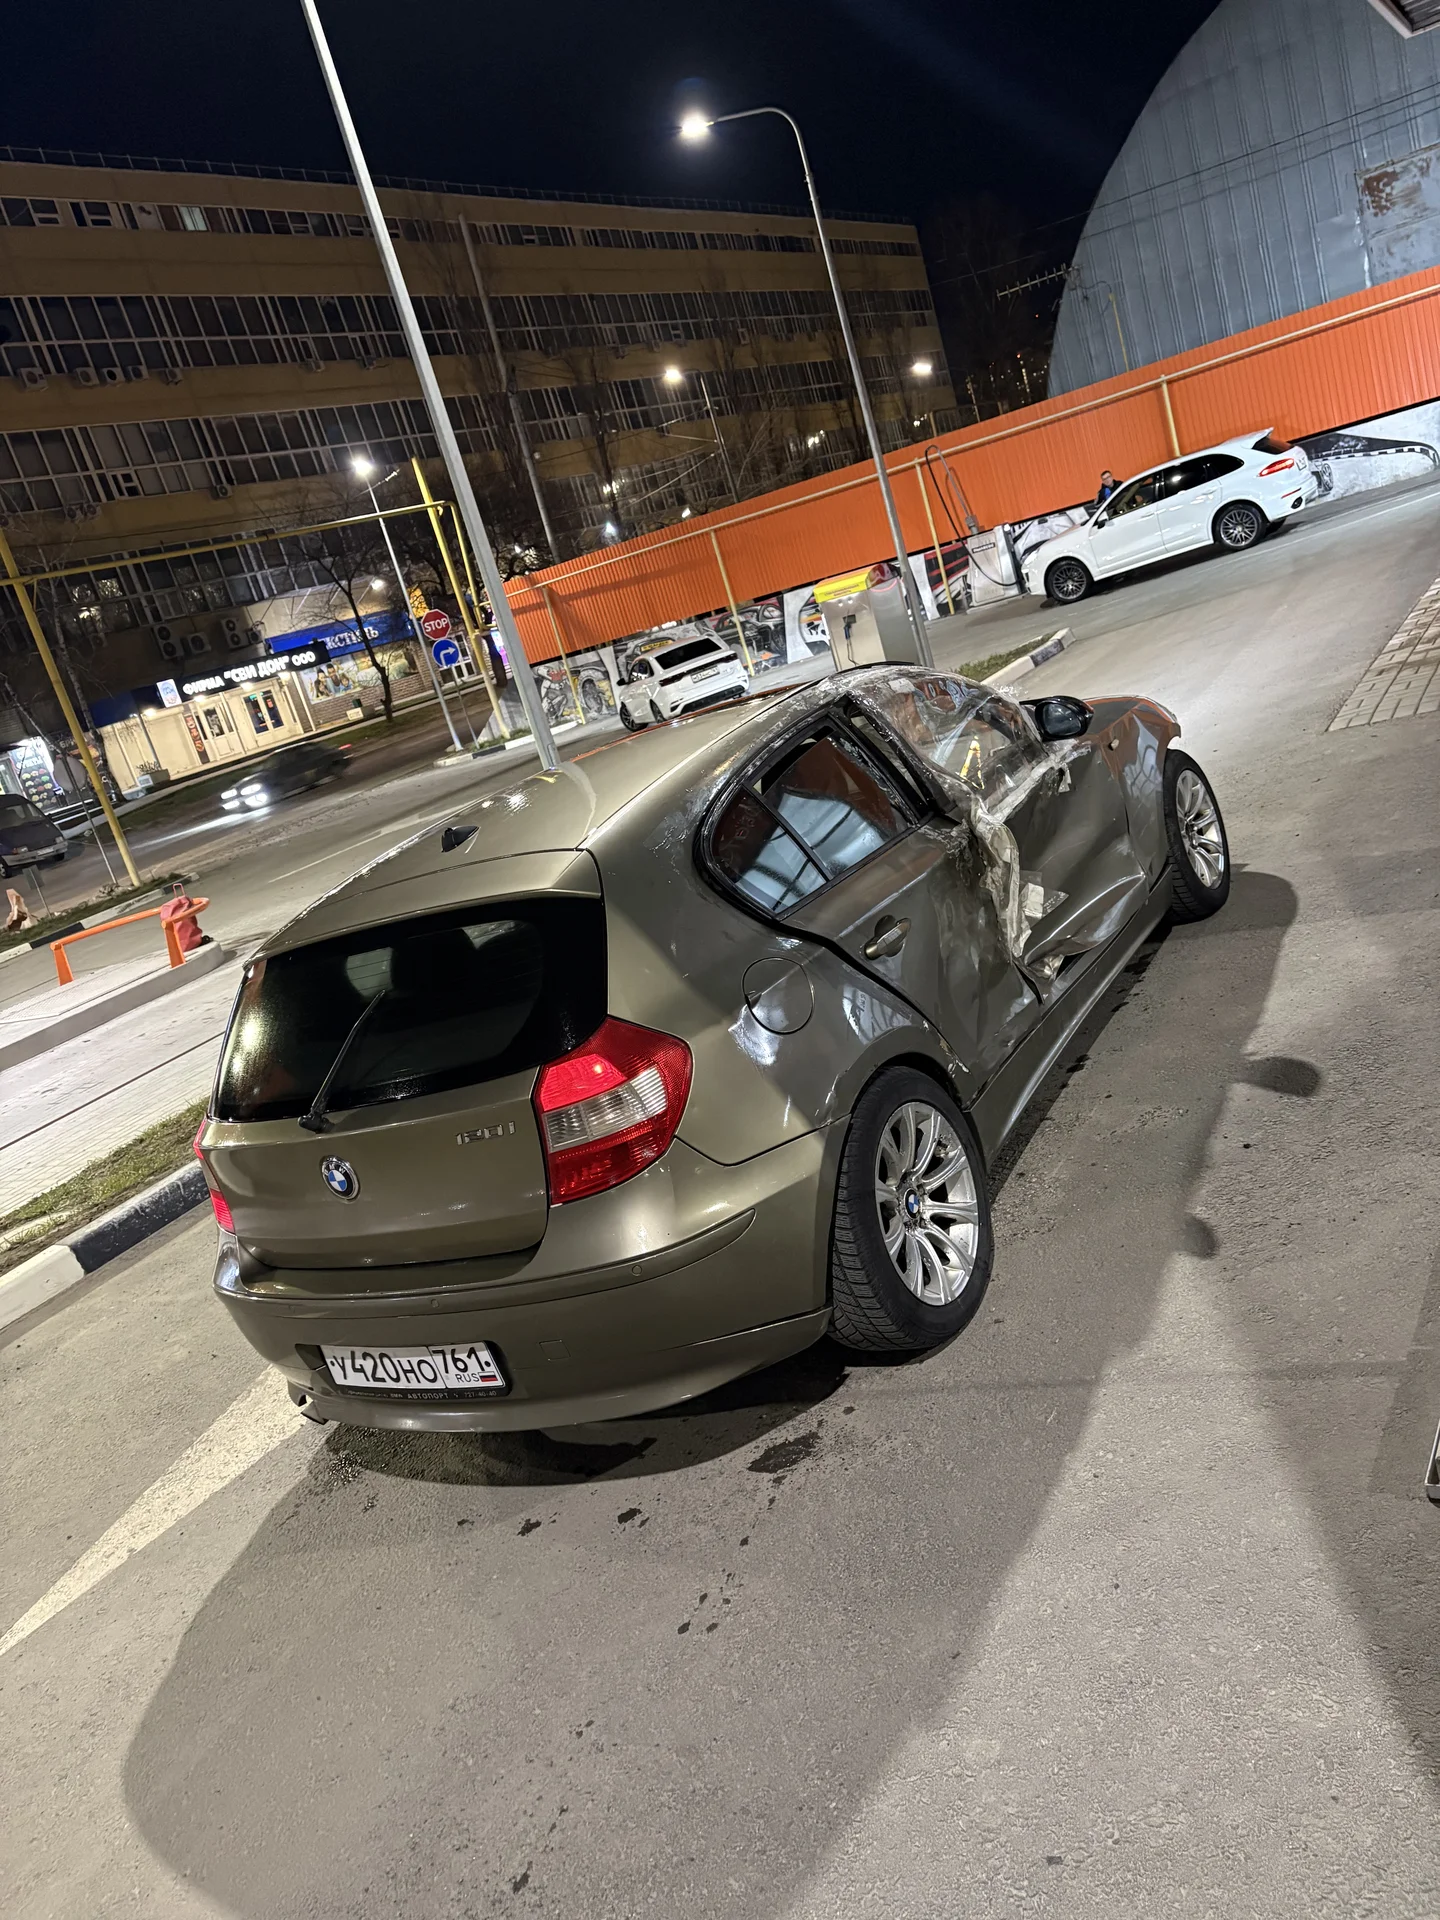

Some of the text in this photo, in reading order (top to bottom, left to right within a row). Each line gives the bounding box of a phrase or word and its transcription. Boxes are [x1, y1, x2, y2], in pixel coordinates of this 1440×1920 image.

[424, 618, 448, 632] STOP
[183, 676, 225, 695] ФИРМА
[291, 651, 316, 666] ООО
[456, 1121, 516, 1146] 120i
[332, 1347, 486, 1384] У420НО 761
[455, 1373, 480, 1384] RUS
[407, 1392, 450, 1400] АВТОПОРТ
